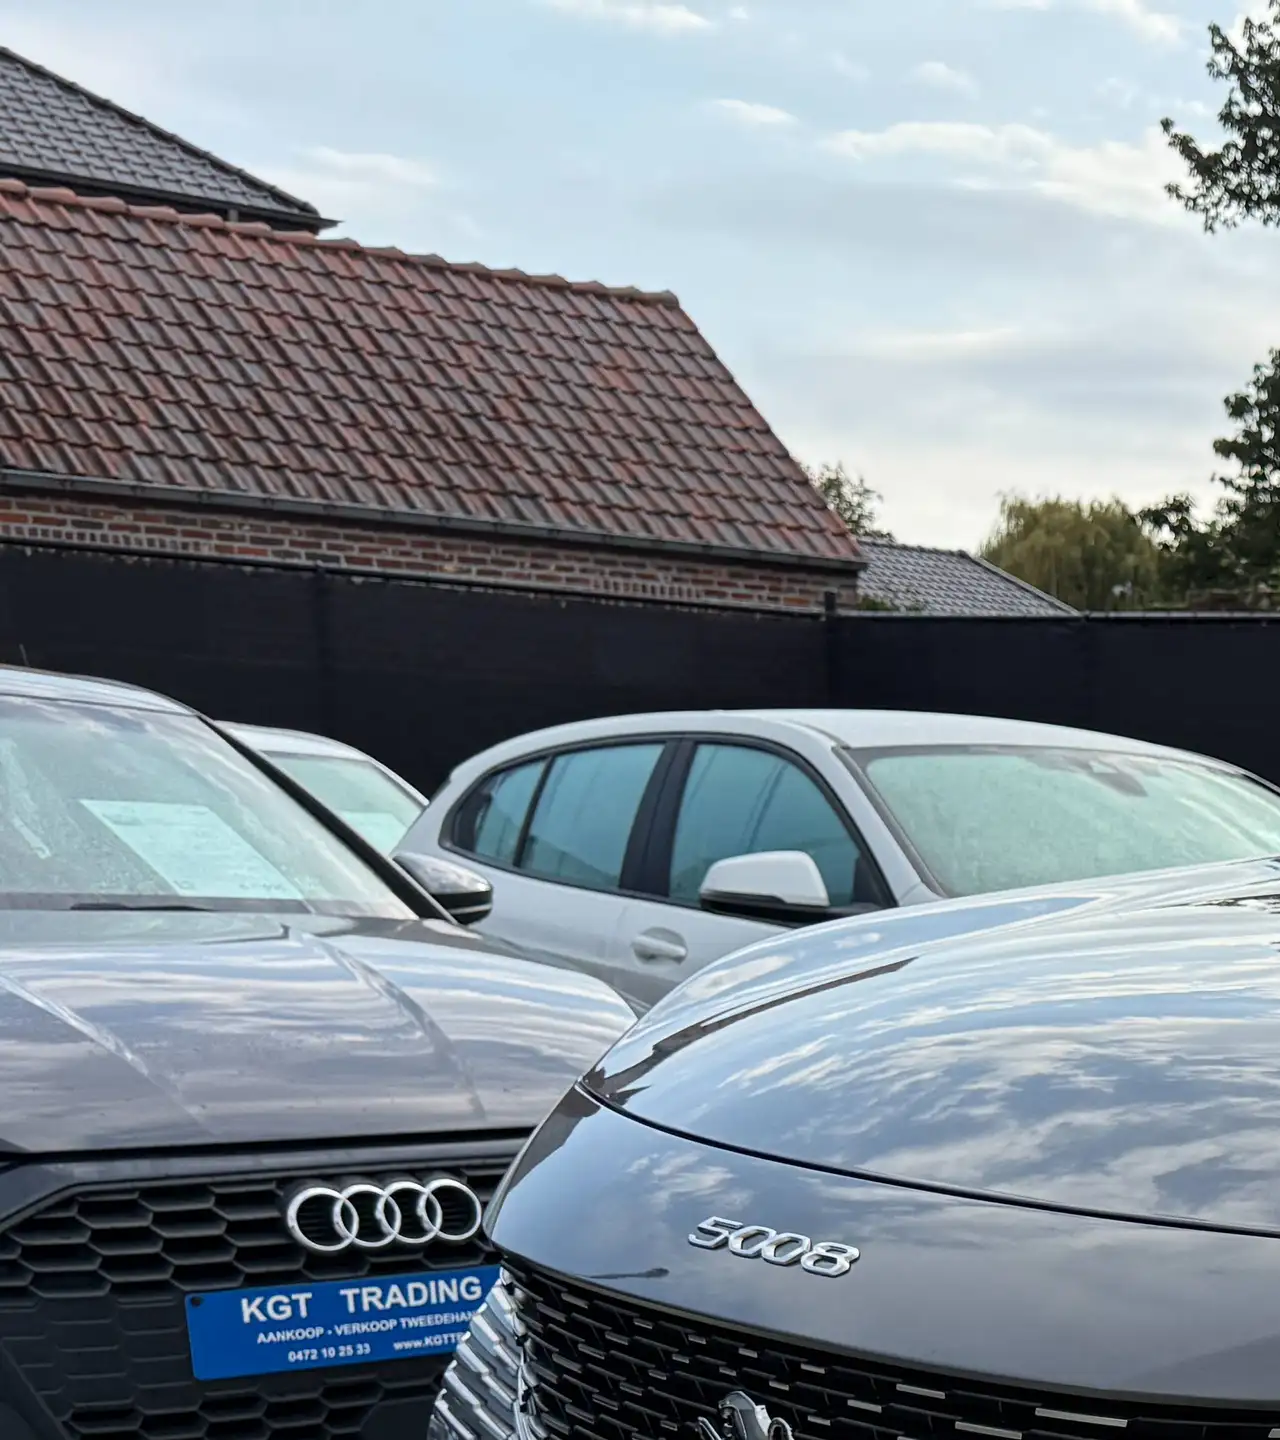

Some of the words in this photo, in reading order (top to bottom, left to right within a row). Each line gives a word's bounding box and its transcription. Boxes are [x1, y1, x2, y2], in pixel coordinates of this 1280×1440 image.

[687, 1215, 861, 1279] 5008
[240, 1293, 313, 1324] KGT
[340, 1276, 483, 1314] TRADING
[256, 1326, 325, 1345] AANKOOP
[334, 1318, 398, 1337] VERKOOP
[287, 1348, 319, 1363] 0472
[355, 1342, 371, 1355] 33
